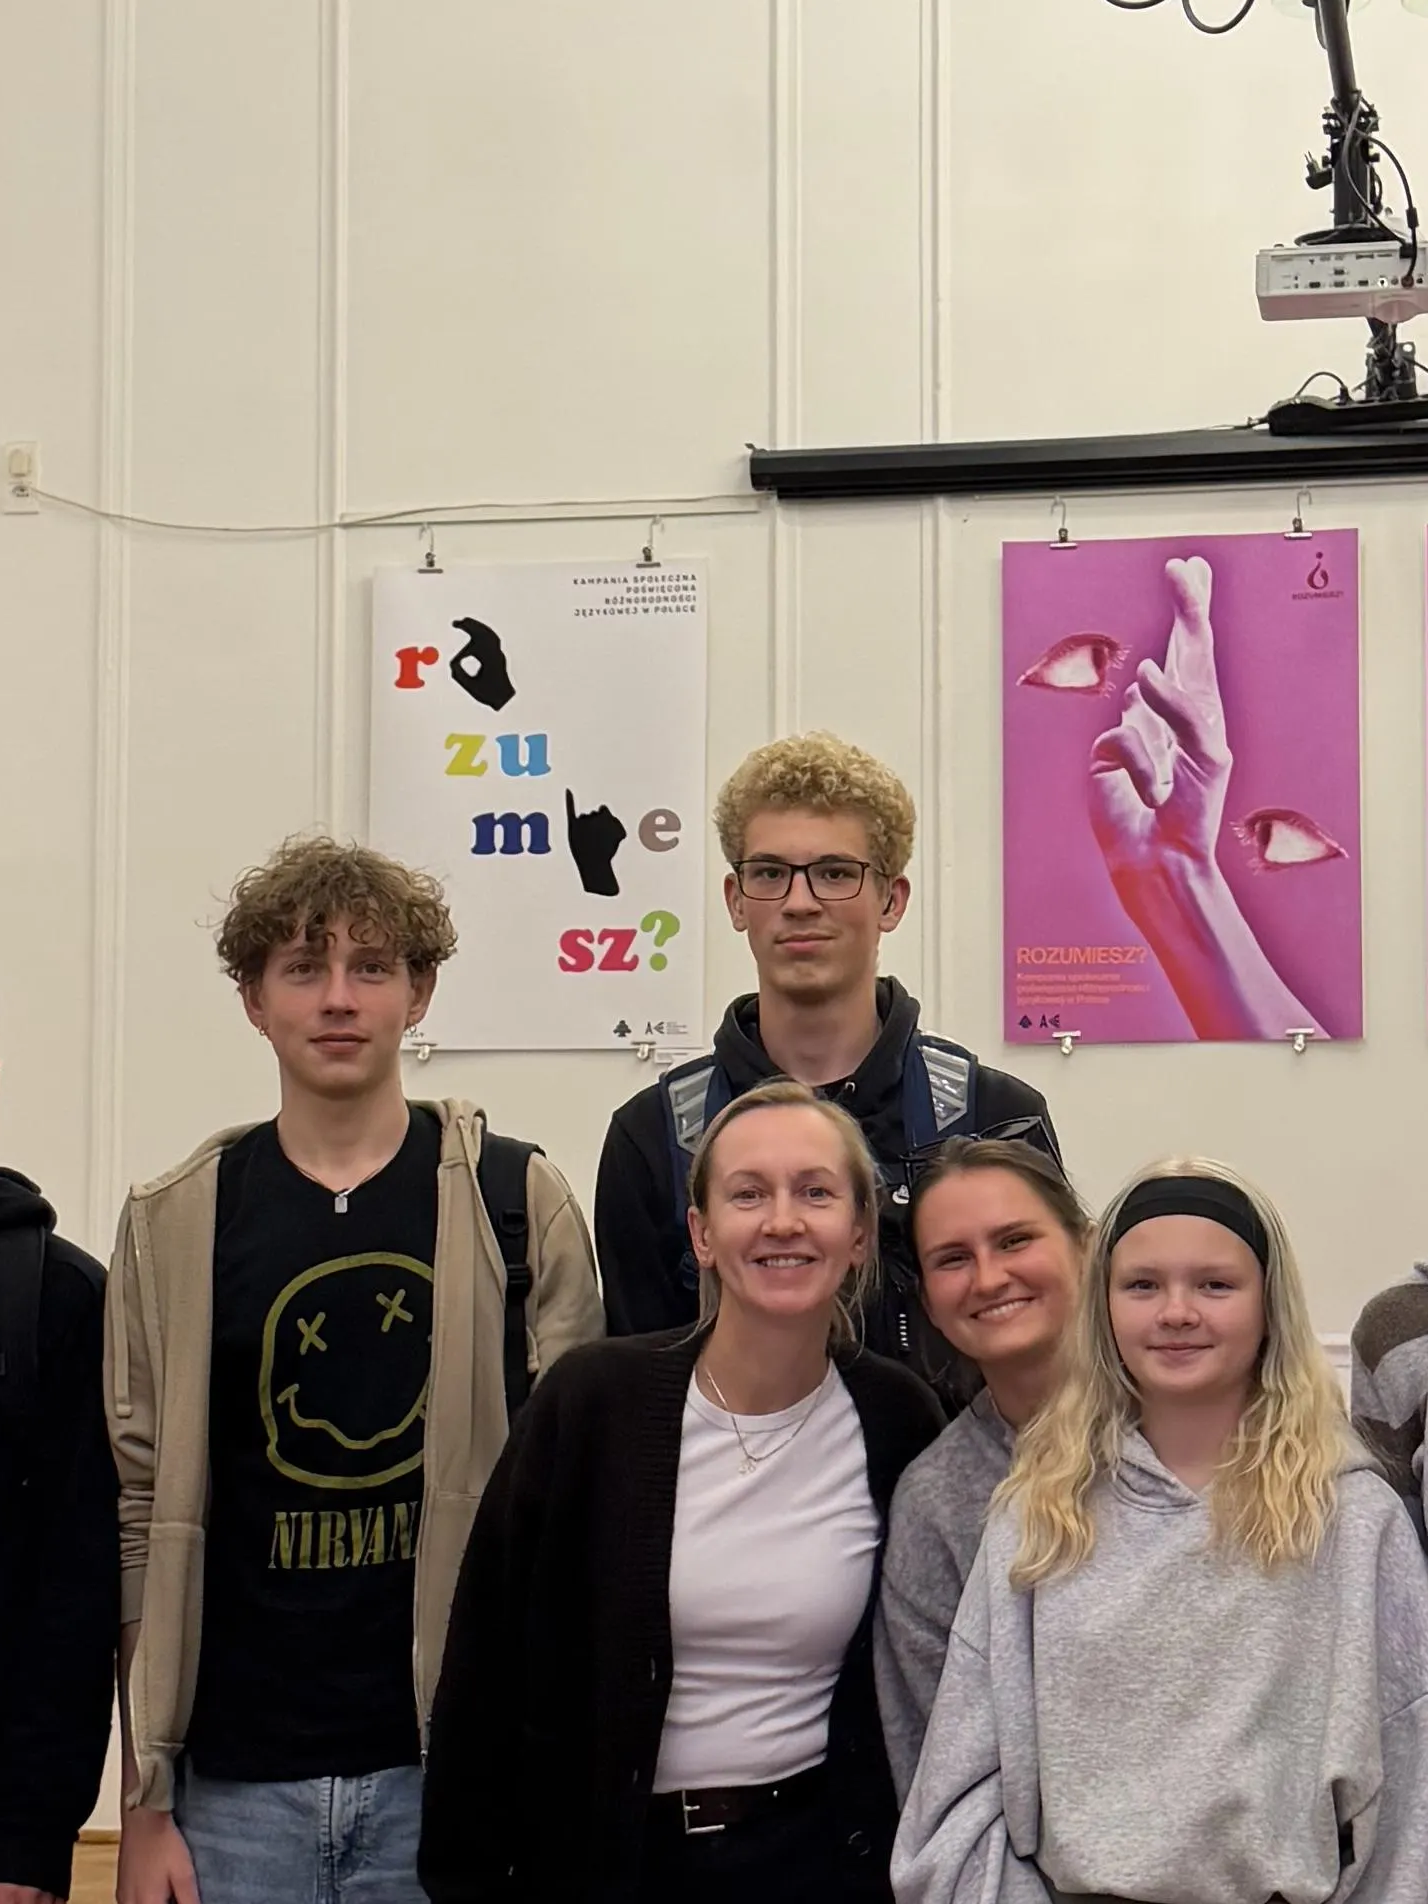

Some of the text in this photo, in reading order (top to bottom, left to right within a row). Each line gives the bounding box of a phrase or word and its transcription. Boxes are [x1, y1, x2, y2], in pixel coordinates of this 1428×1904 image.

[573, 576, 629, 585] KAMPANIA
[558, 910, 681, 973] sz?
[1016, 946, 1147, 965] ROZUMIESZ?
[268, 1501, 419, 1569] NIRVAN
